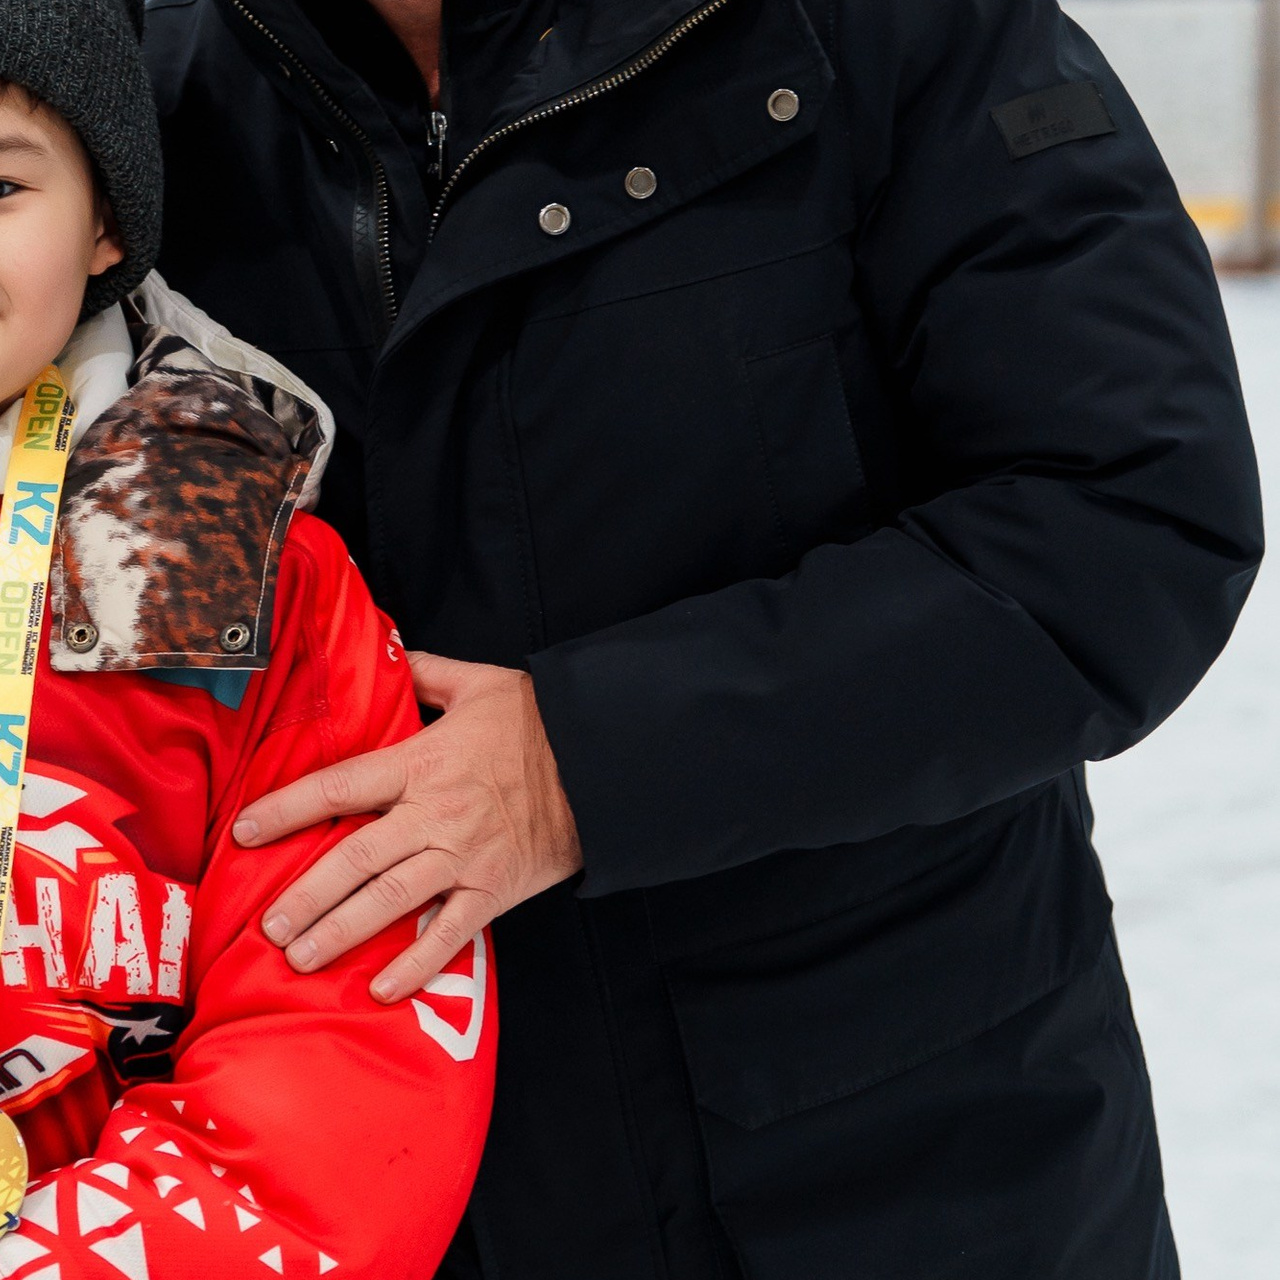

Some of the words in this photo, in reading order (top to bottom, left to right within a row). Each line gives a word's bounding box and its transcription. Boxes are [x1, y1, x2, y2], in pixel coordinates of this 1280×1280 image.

[24, 382, 64, 451] OPEN
[8, 481, 59, 546] KZ
[2, 826, 13, 876] KAZAKHSTAN
